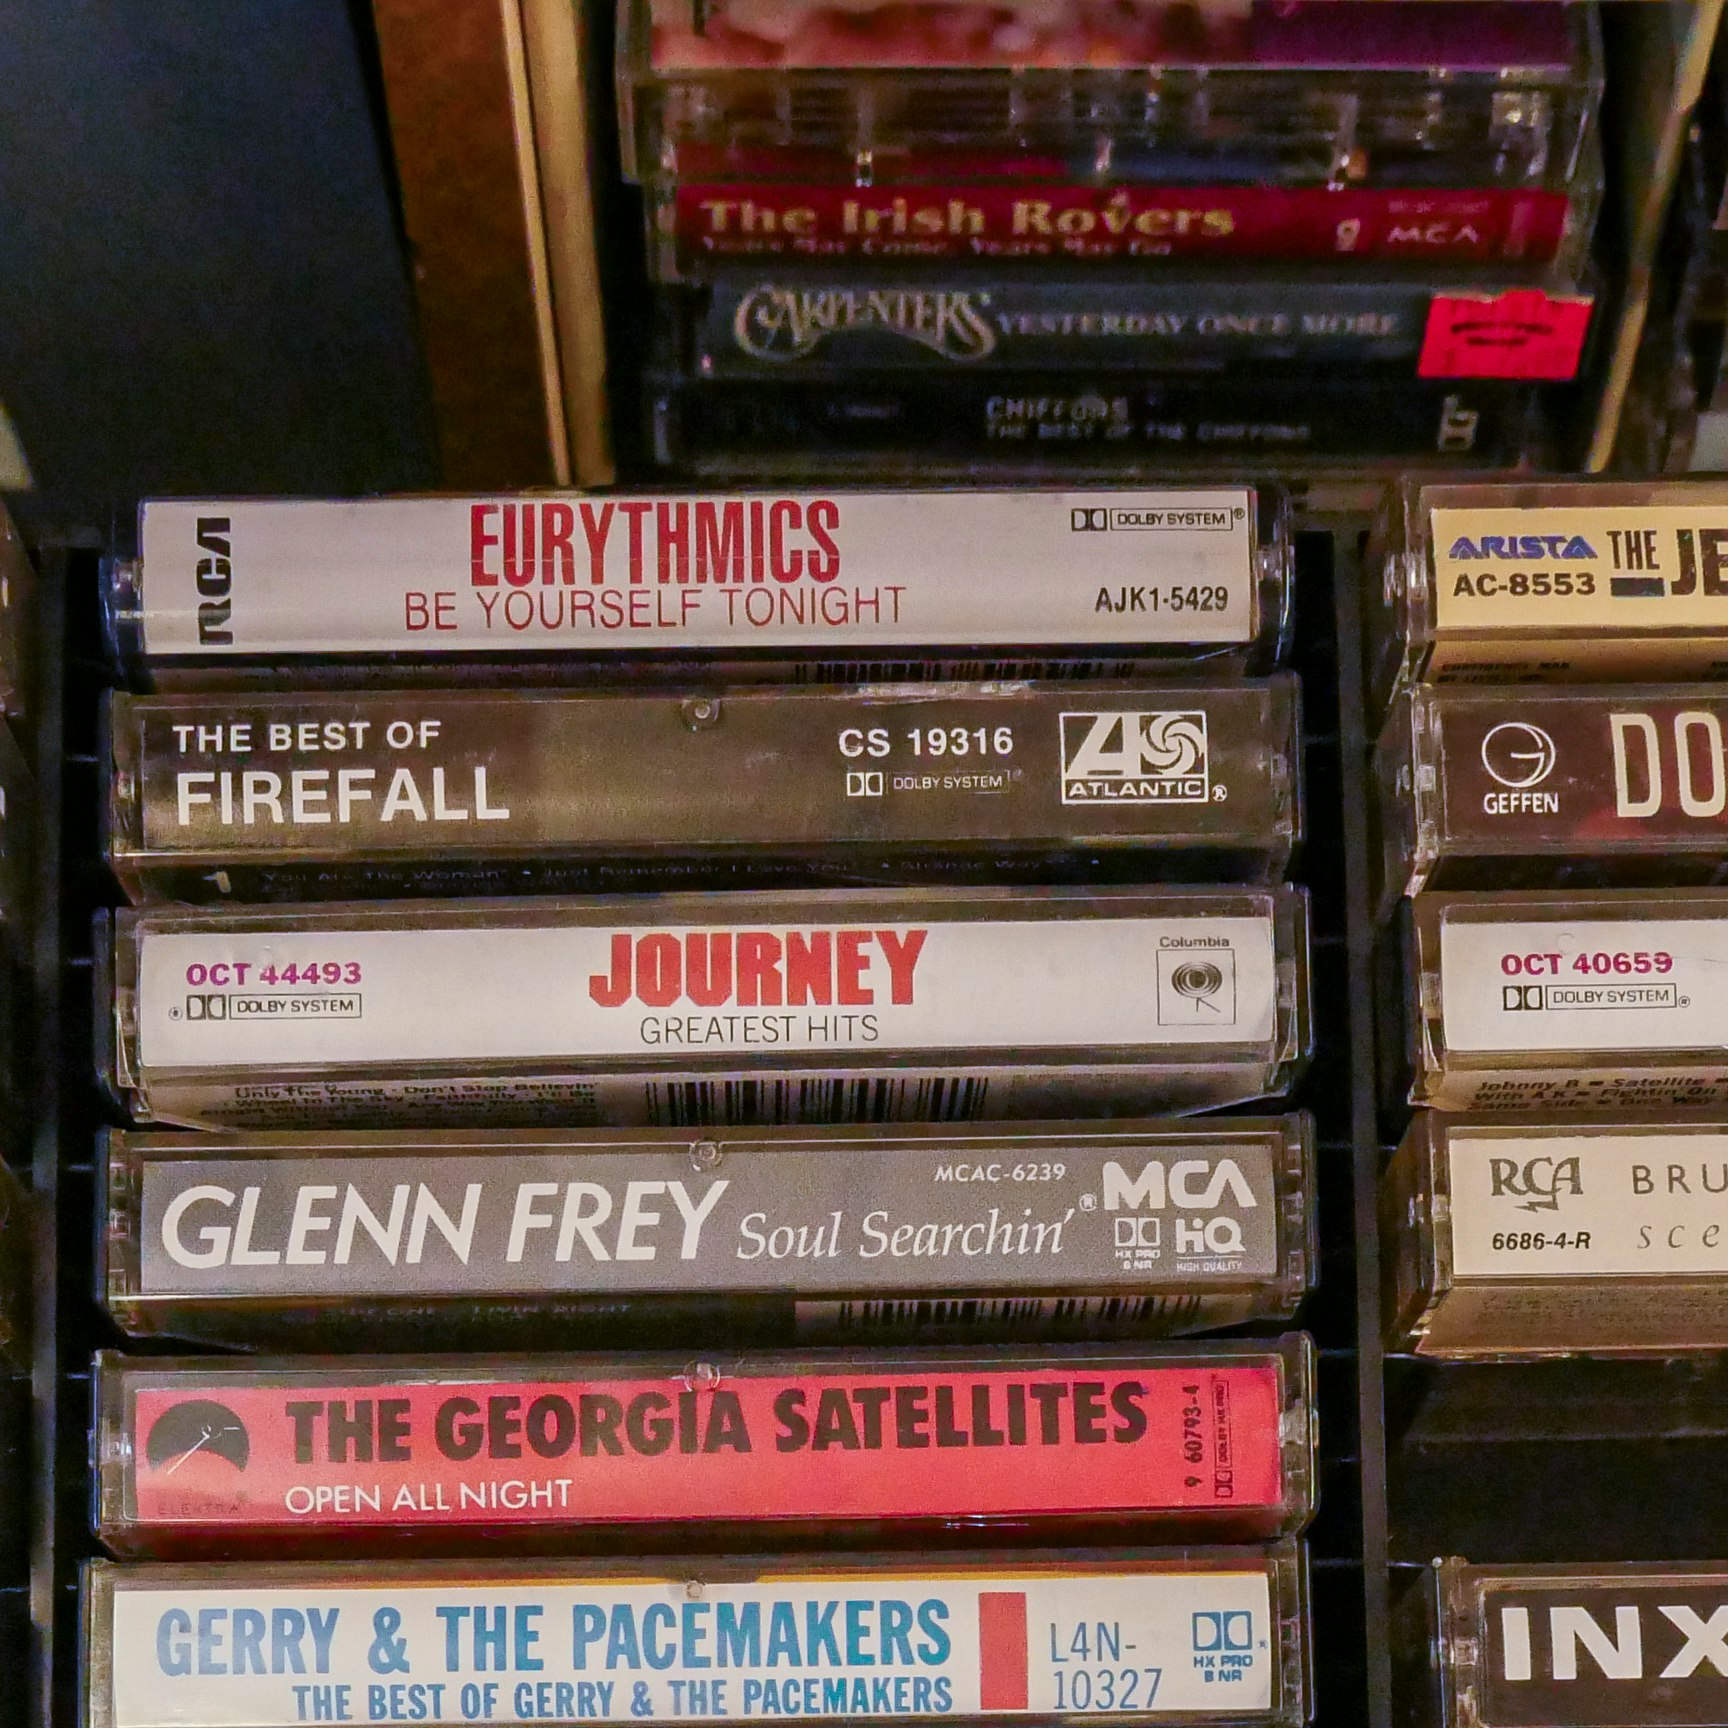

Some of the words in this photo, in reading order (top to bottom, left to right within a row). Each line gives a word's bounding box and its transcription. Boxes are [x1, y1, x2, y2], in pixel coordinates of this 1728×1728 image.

[701, 200, 818, 233] The
[843, 198, 986, 234] Irish
[1013, 199, 1235, 235] Rovers
[470, 500, 841, 588] EURYTHMICS
[1606, 530, 1660, 571] THE
[404, 591, 457, 631] BE
[478, 589, 701, 631] YOURSELF
[726, 586, 908, 627] TONIGHT
[173, 724, 253, 753] THE
[269, 722, 371, 752] BEST
[385, 721, 441, 750] OF
[838, 730, 892, 758] CS
[907, 727, 1014, 757] 19316
[177, 766, 510, 826] FIREFALL
[1483, 793, 1560, 815] GEFFEN
[187, 964, 252, 986] OCT
[259, 962, 363, 986] 44493
[589, 929, 928, 1008] JOURNEY
[236, 999, 287, 1015] DOLBY
[290, 998, 354, 1014] SYSTEM
[640, 1014, 793, 1045] GREATEST
[808, 1013, 880, 1043] HITS
[934, 1163, 1067, 1184] MCAC-6239
[161, 1182, 482, 1269] GLENN
[506, 1180, 730, 1263] FREY
[736, 1211, 842, 1260] Soul
[858, 1207, 1075, 1259] Searchin'
[1491, 1231, 1592, 1254] 6686-4-R
[286, 1400, 411, 1464] THE
[435, 1390, 752, 1462] GEORGIA
[774, 1380, 1149, 1453] SATELLITES
[285, 1484, 381, 1514] OPEN
[392, 1482, 451, 1513] ALL
[459, 1479, 573, 1510] NIGHT
[156, 1607, 340, 1678] GERRY
[368, 1606, 411, 1675] &
[436, 1605, 544, 1673] THE
[573, 1598, 952, 1672] PACEMAKERS
